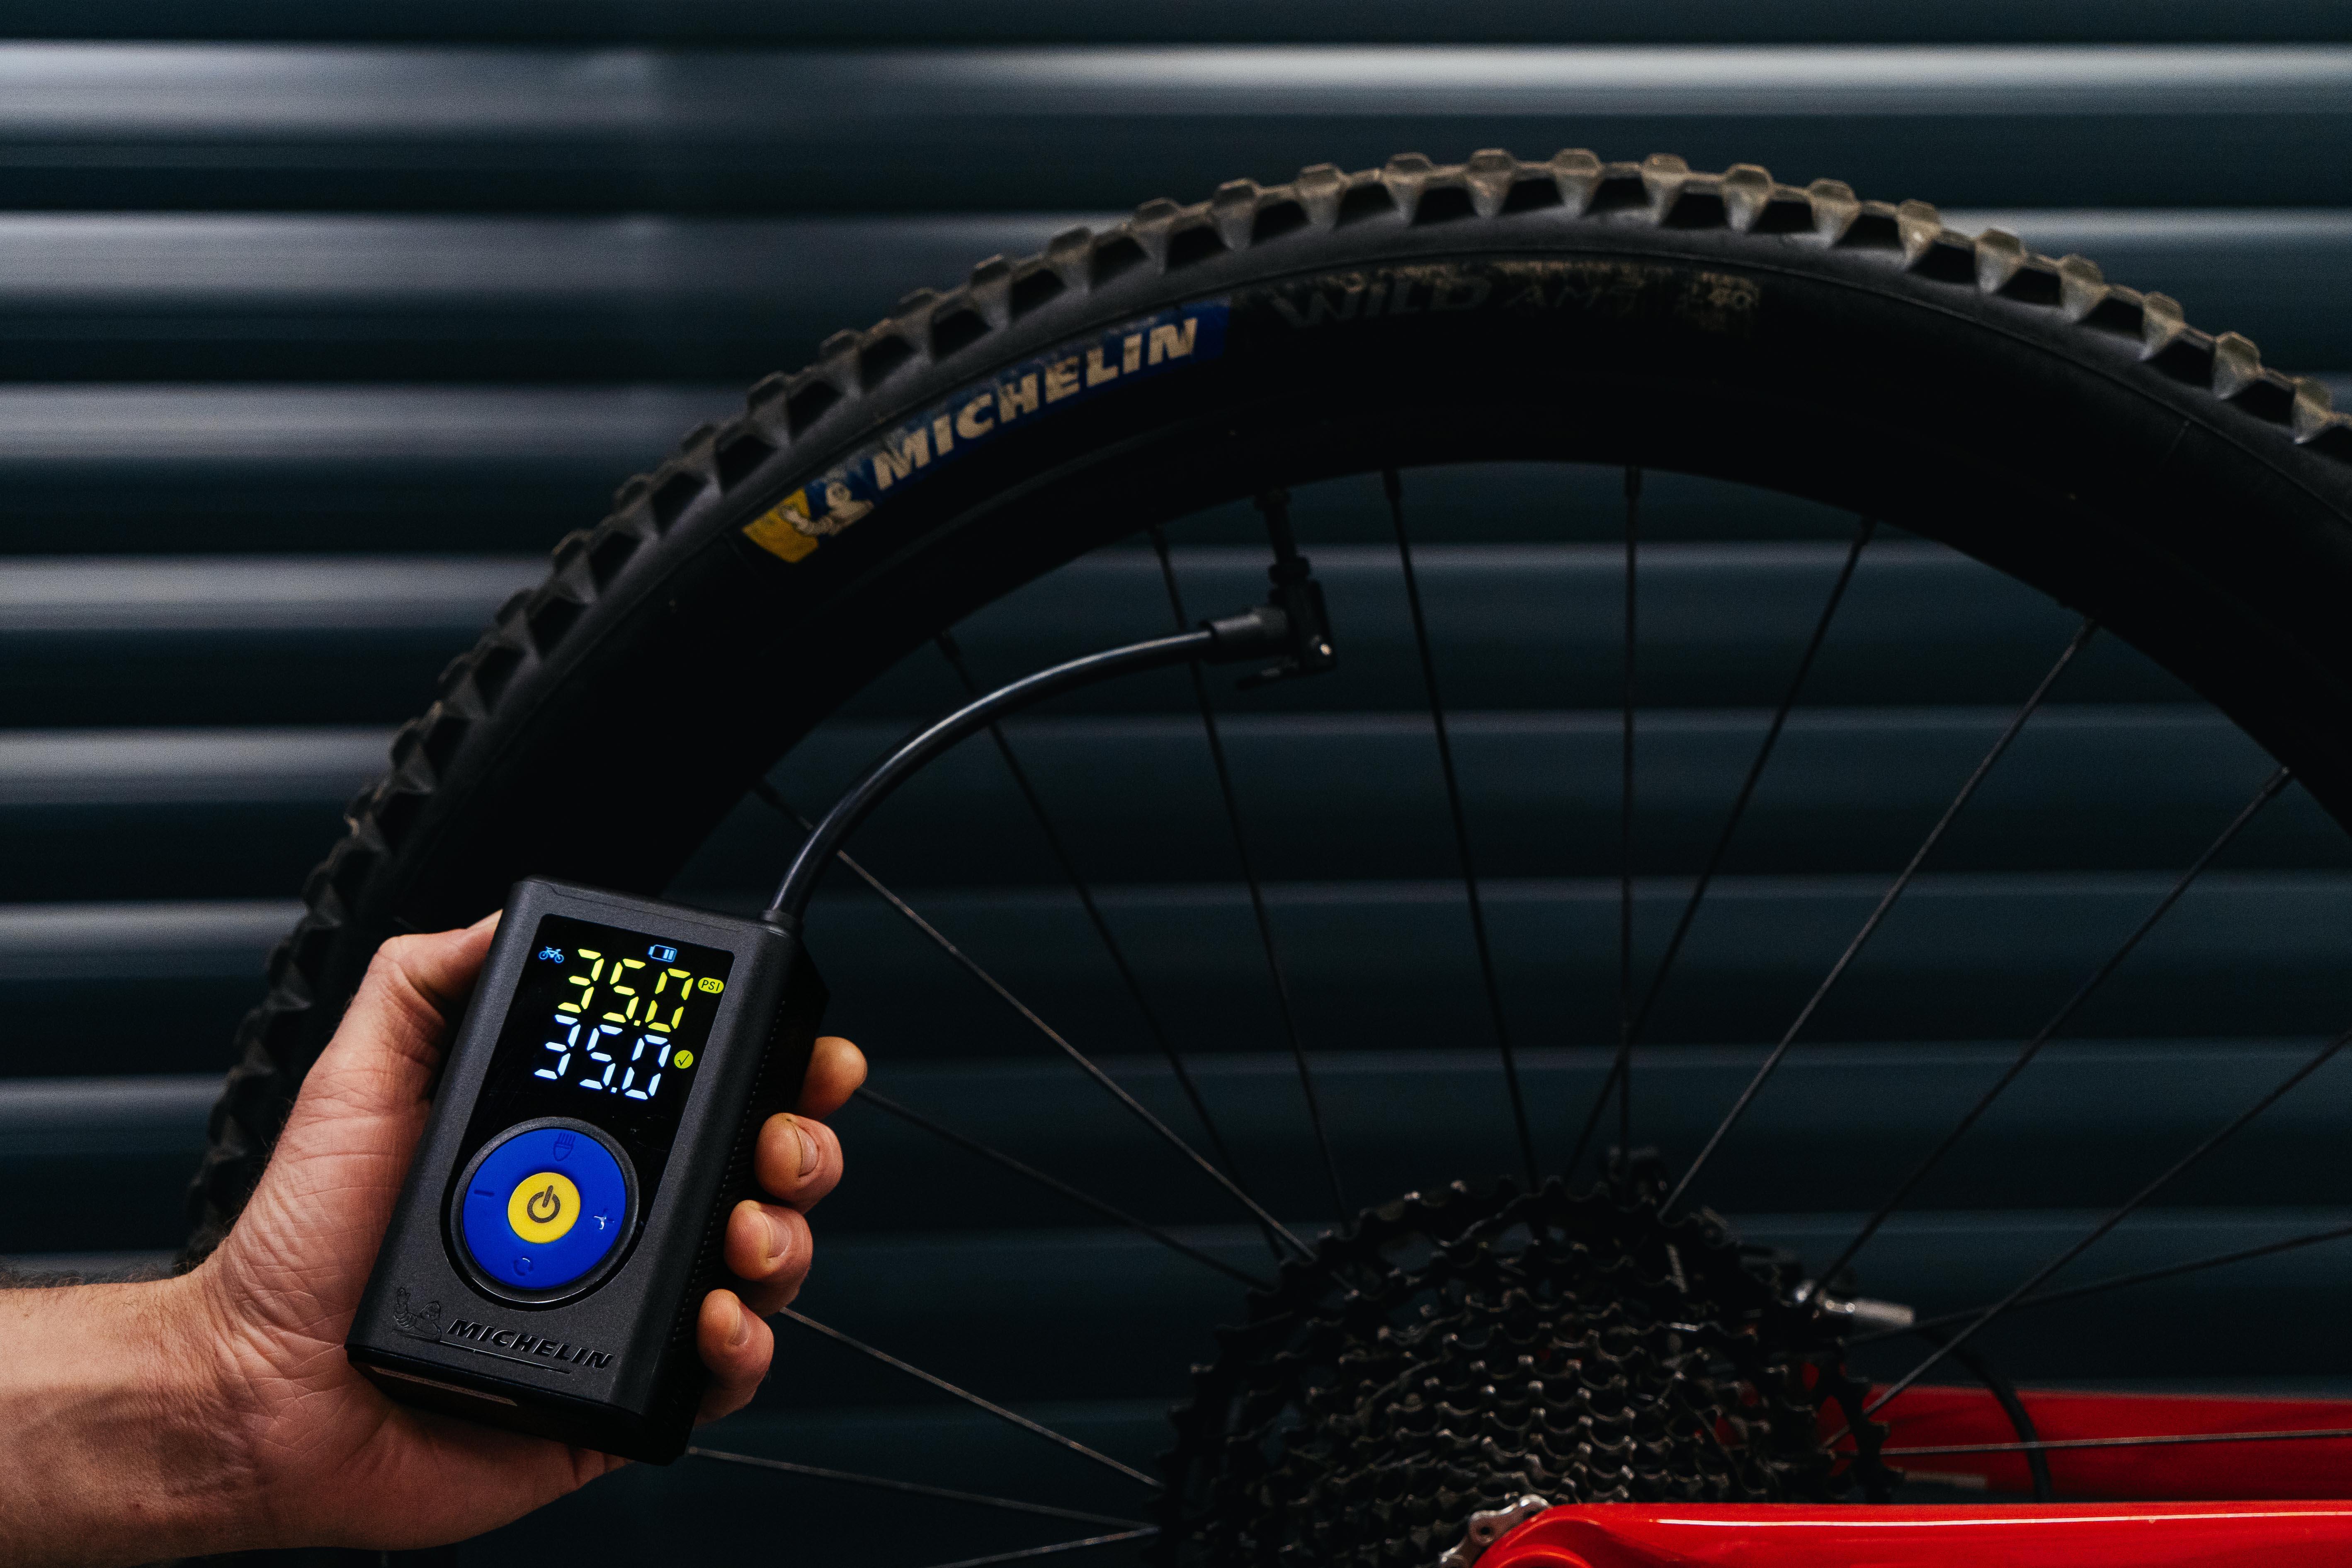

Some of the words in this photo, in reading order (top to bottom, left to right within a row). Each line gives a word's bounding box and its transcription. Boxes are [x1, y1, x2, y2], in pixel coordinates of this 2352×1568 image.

[870, 317, 1198, 491] MICHELIN
[558, 948, 694, 1033] 35.0
[701, 979, 721, 993] PSI
[534, 1014, 671, 1100] 35.0
[446, 1318, 614, 1370] MICHELIN
